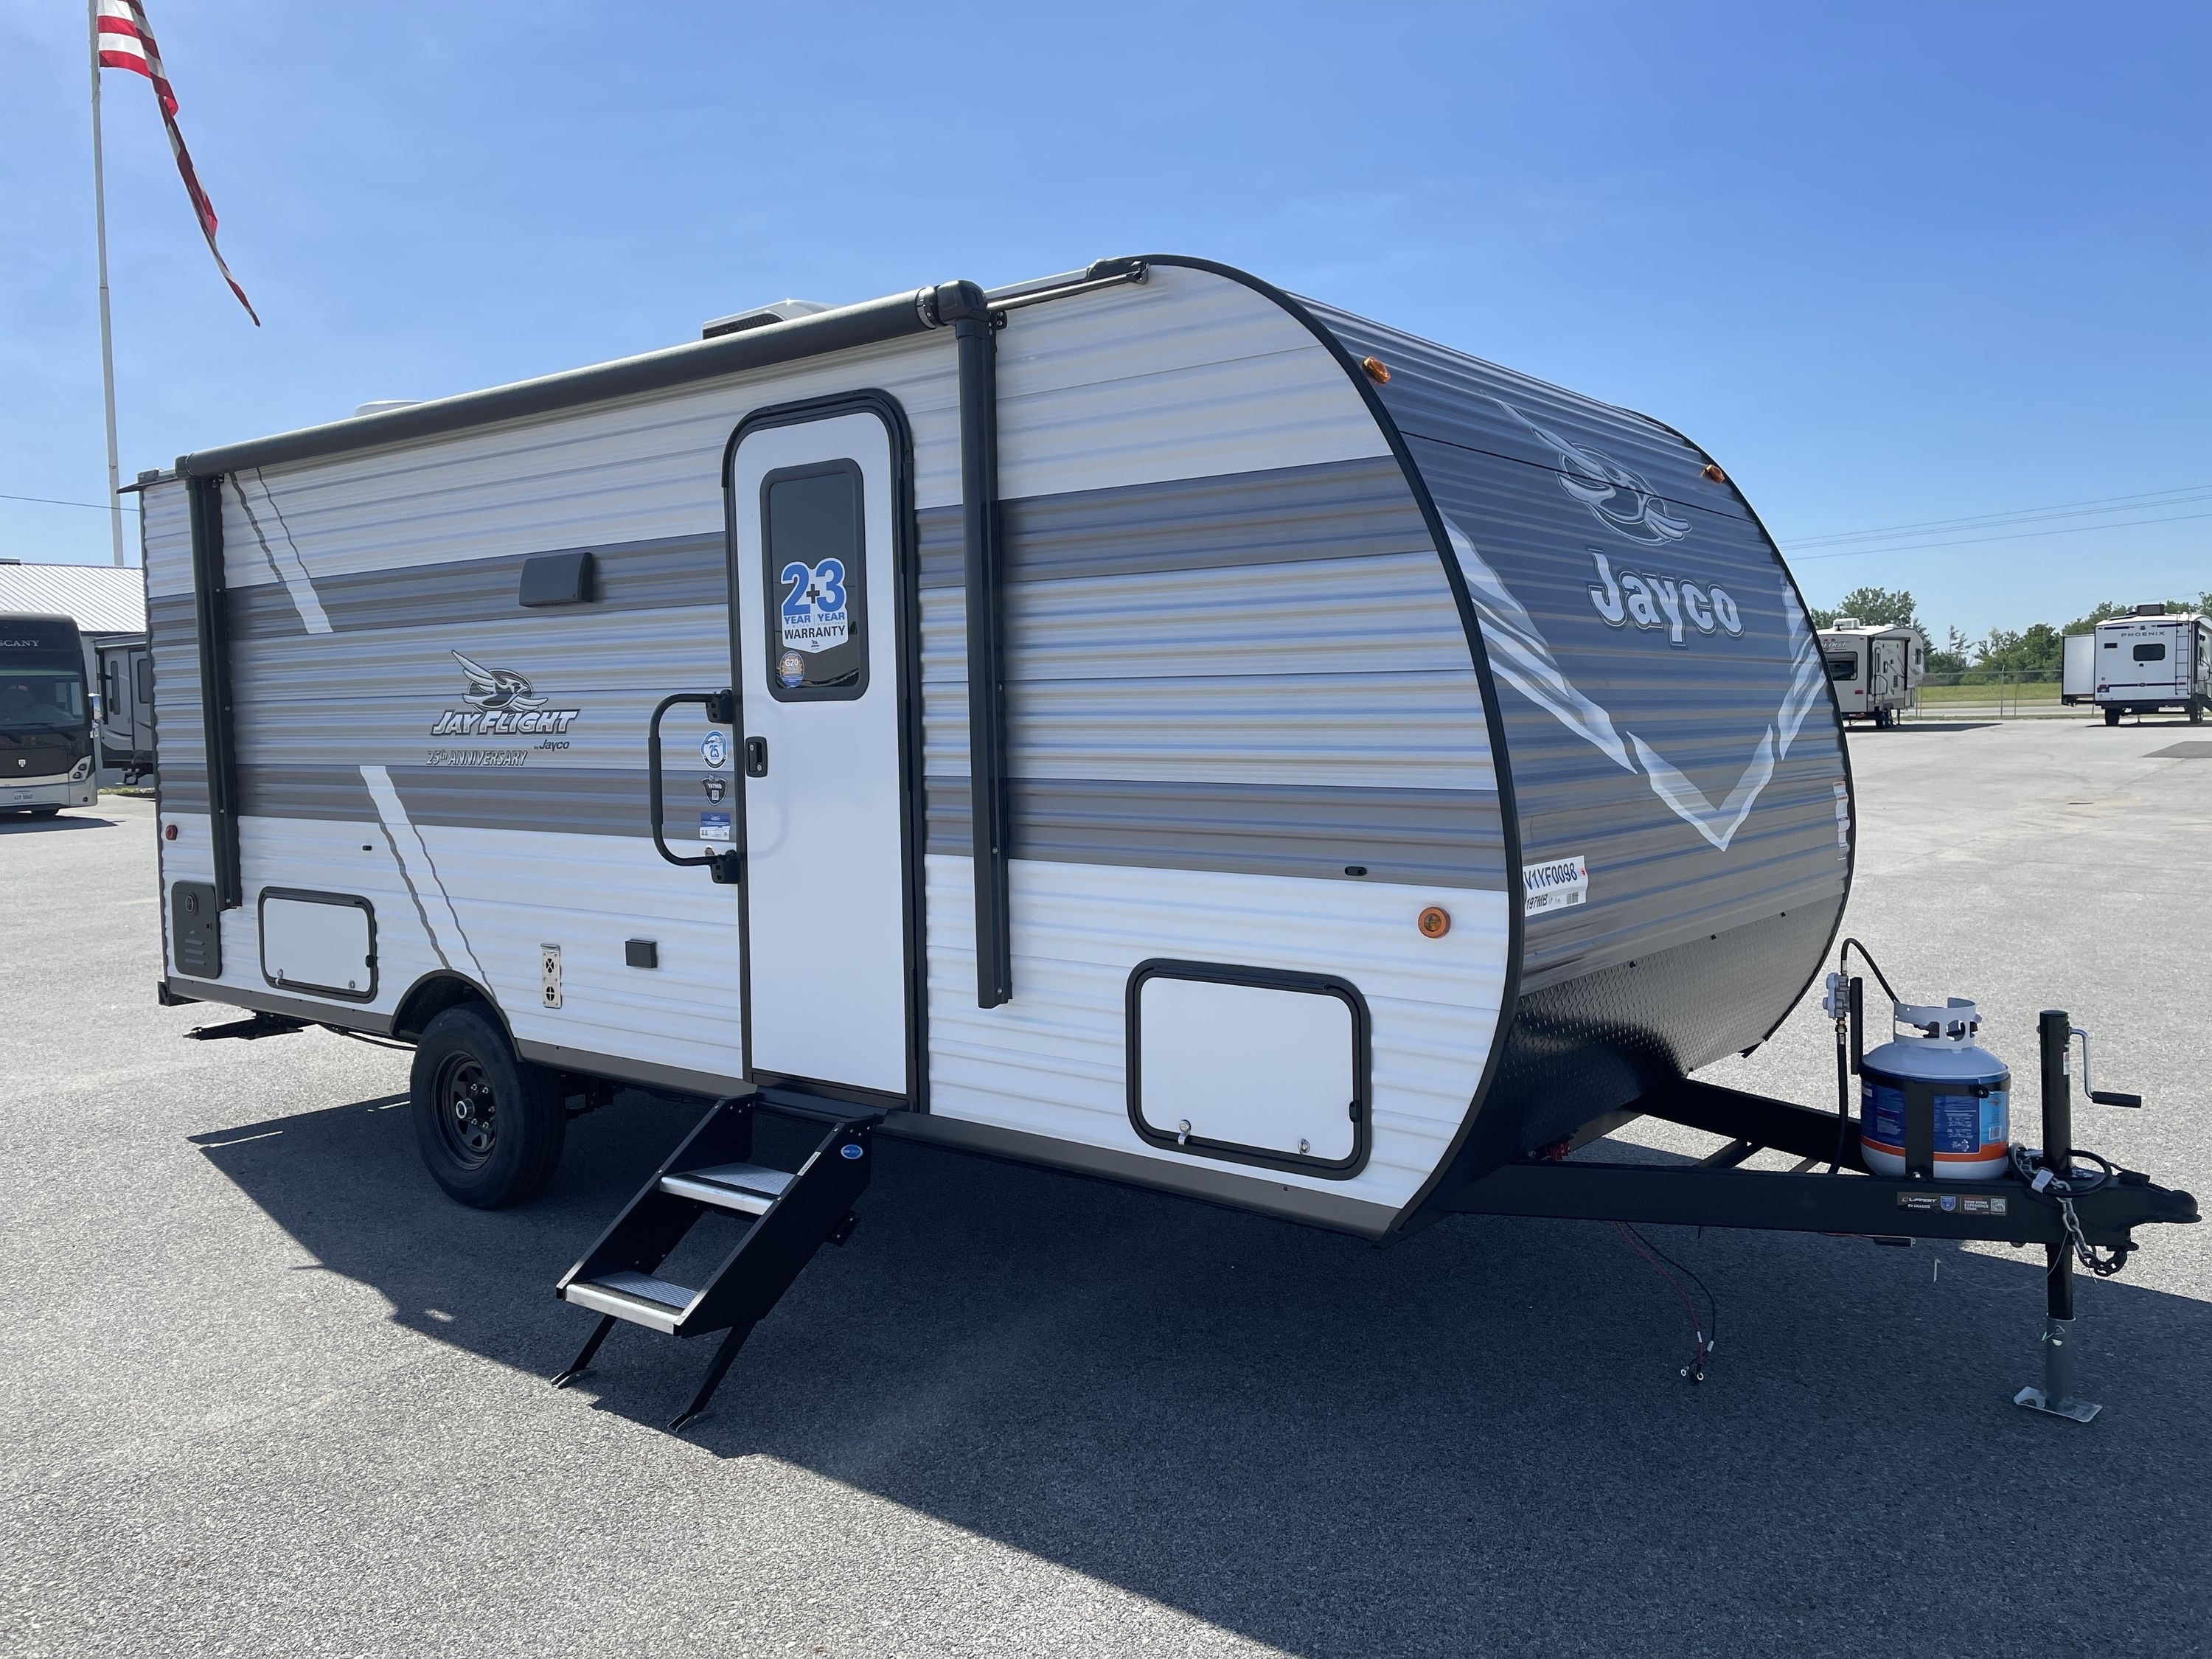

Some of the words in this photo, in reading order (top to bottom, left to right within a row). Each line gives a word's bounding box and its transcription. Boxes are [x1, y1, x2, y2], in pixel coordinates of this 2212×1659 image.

[1587, 548, 1745, 647] Jayco
[784, 615, 810, 625] YEAR
[817, 612, 845, 622] YEAR
[785, 625, 845, 639] WARRANTY
[431, 709, 481, 735] JAY
[479, 708, 580, 734] FLIGHT
[540, 739, 570, 751] Jayco
[448, 751, 528, 766] ANNIVERSARY
